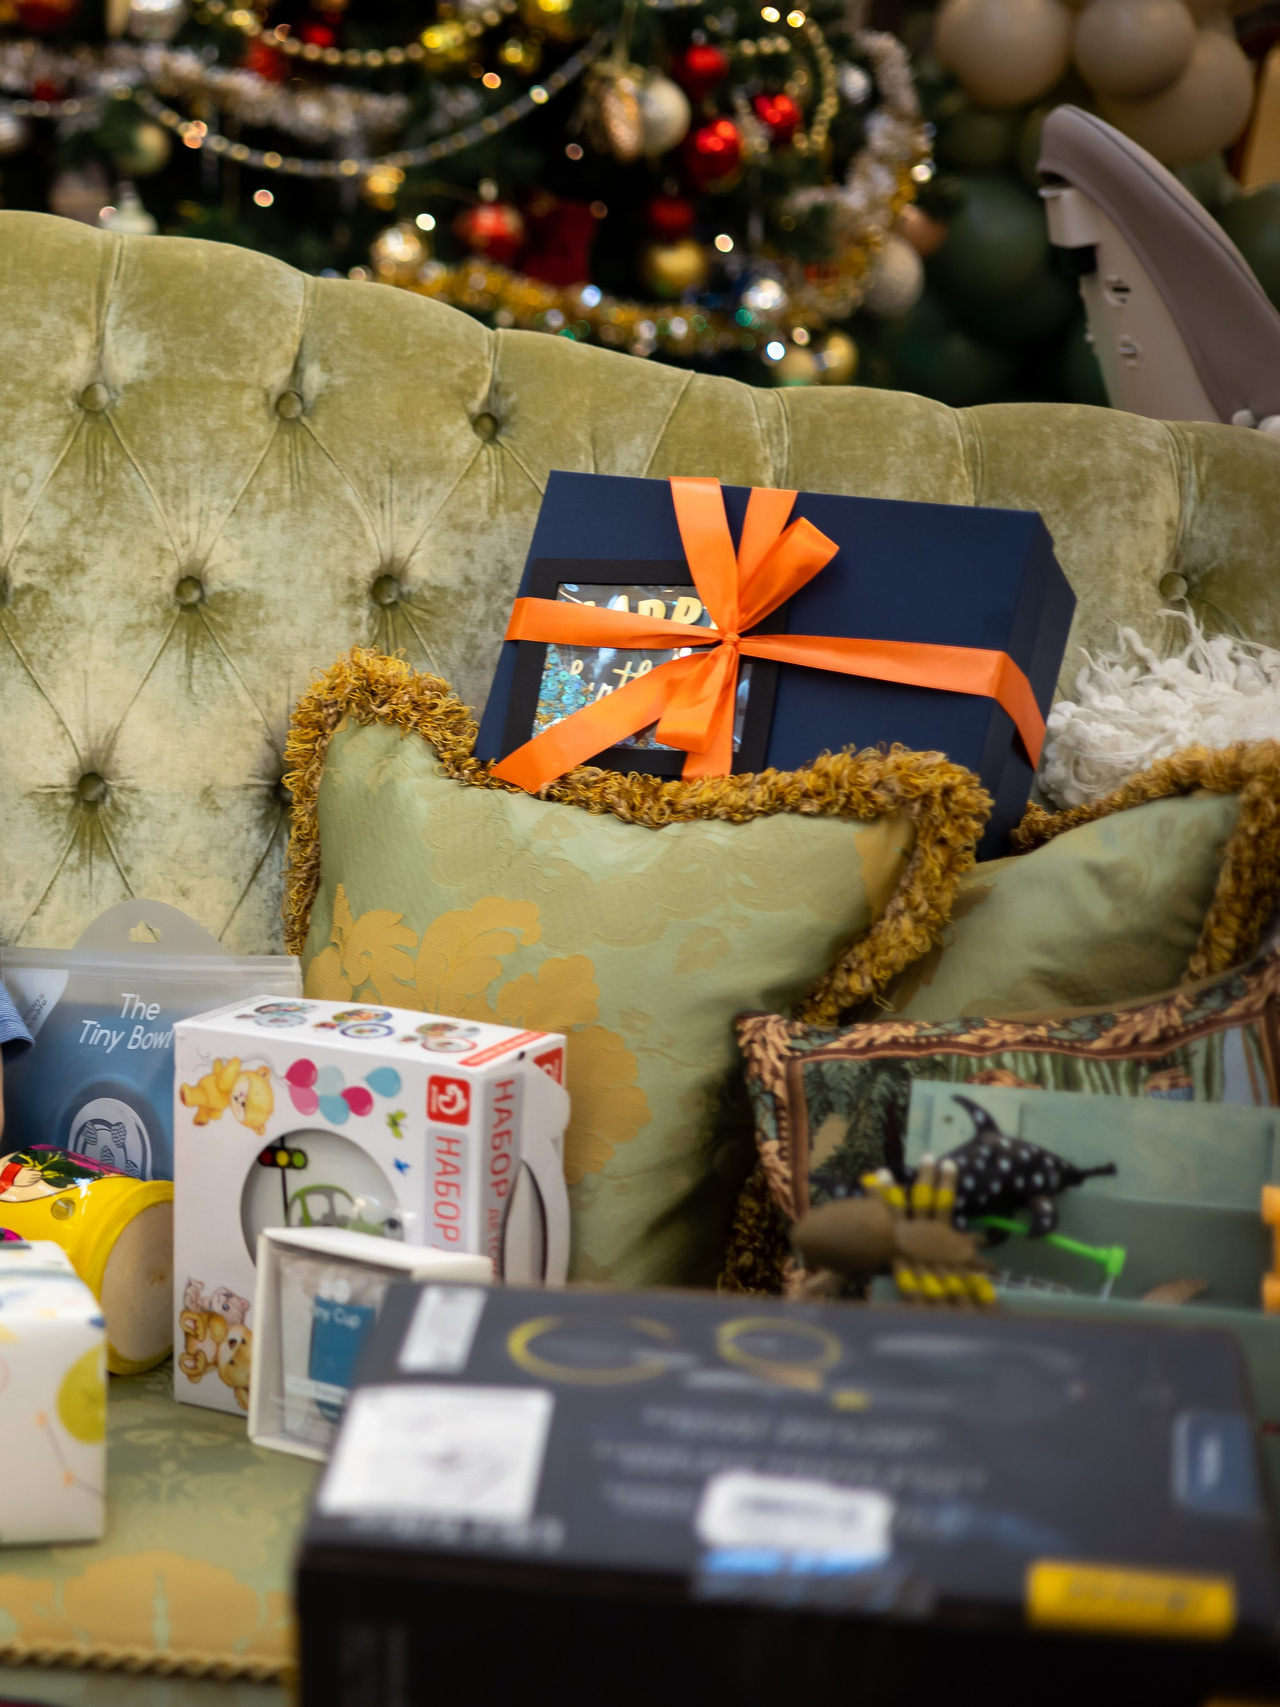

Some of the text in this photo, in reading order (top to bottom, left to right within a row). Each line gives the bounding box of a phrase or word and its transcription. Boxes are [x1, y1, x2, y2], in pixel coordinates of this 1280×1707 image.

[79, 1019, 174, 1054] Tiny Bowl
[120, 992, 161, 1021] The
[490, 1079, 516, 1199] НАБОР
[433, 1135, 462, 1244] НАБОР
